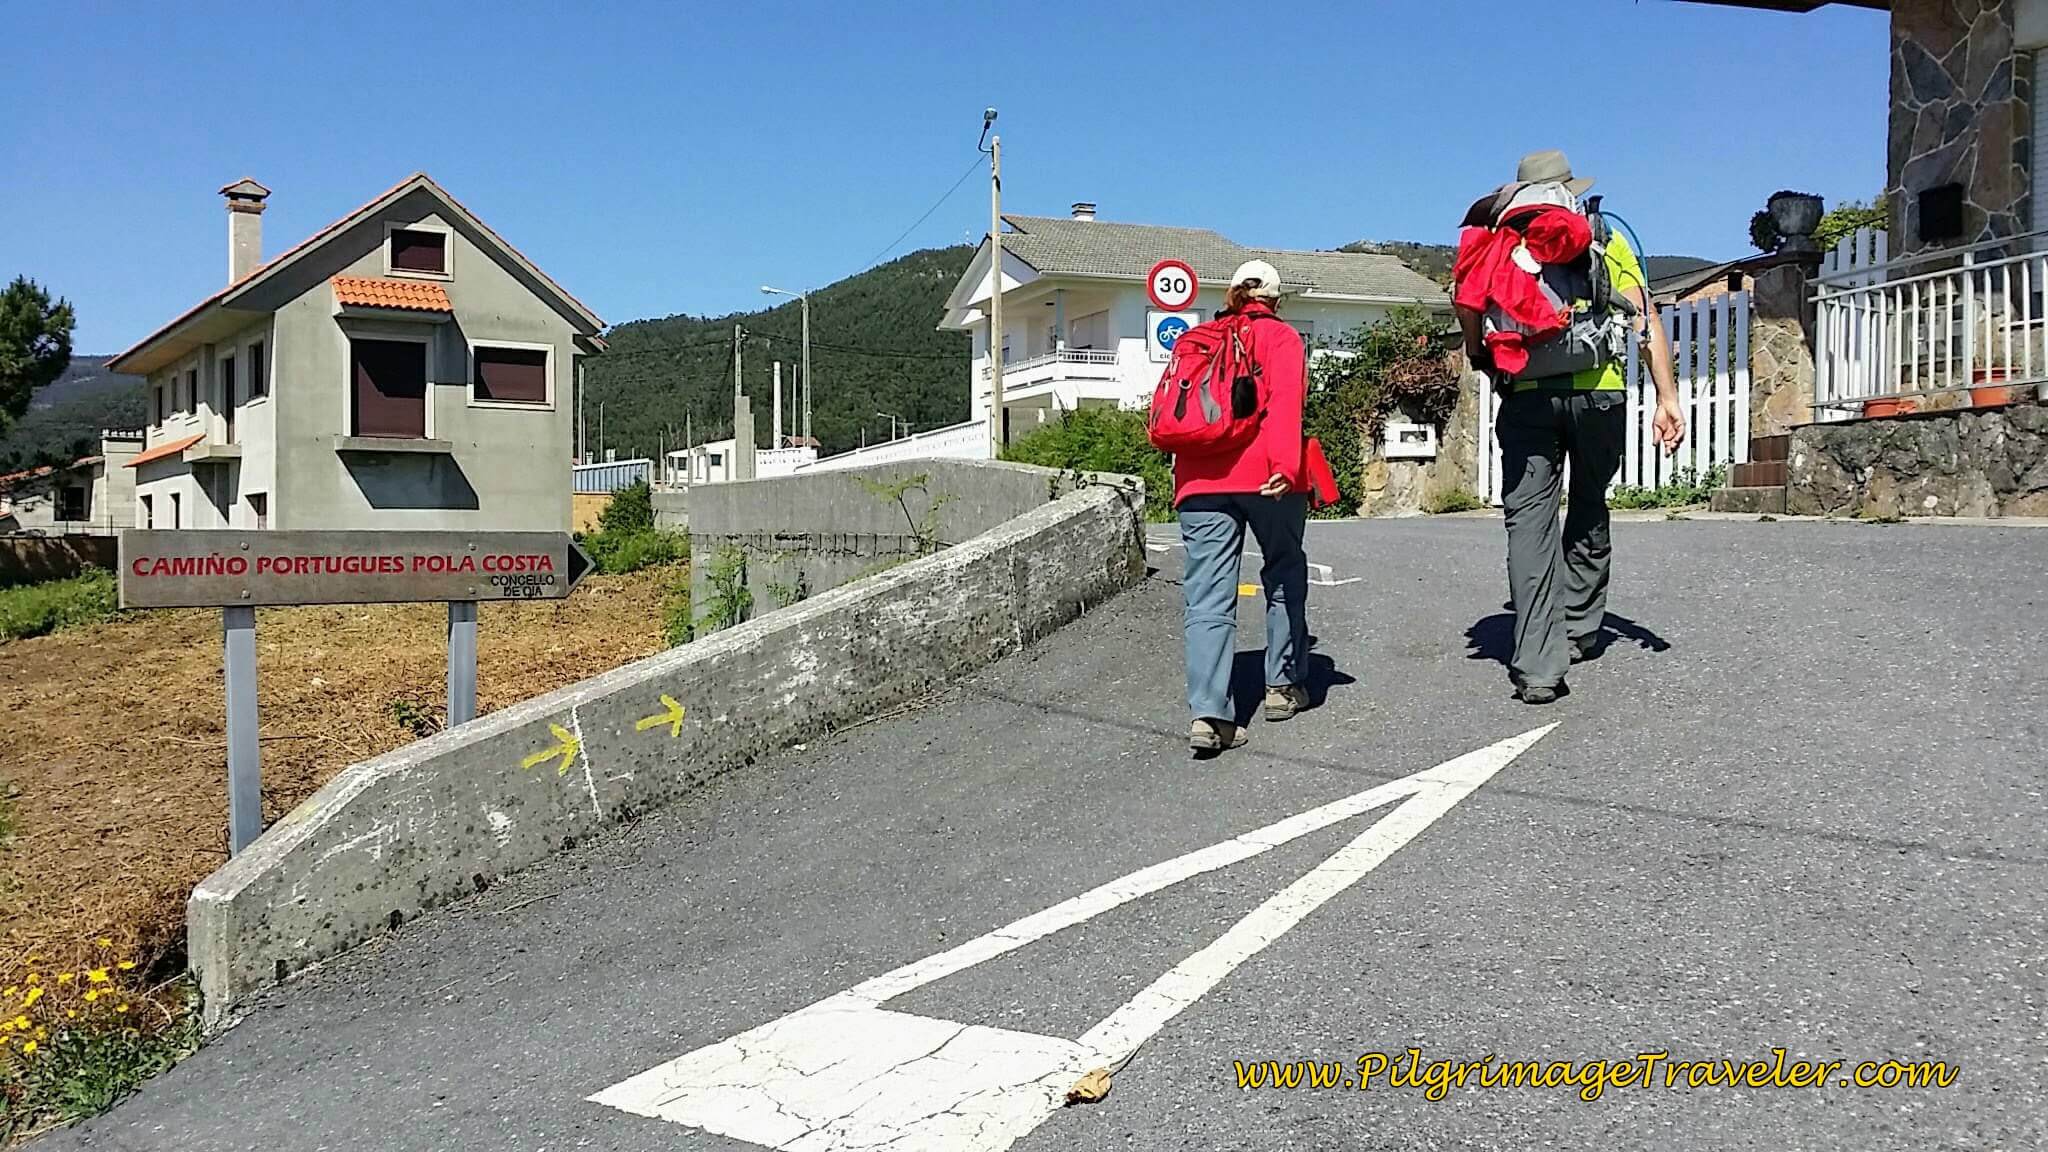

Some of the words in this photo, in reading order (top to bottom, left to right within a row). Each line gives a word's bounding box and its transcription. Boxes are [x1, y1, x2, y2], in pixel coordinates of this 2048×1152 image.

[1159, 277, 1186, 293] 30
[132, 553, 248, 577] CAMIÑO
[256, 555, 405, 575] PORTUGUES
[412, 555, 476, 574] POLA
[482, 554, 554, 573] COSTA
[490, 574, 555, 586] CONCELLO
[503, 586, 521, 597] DE
